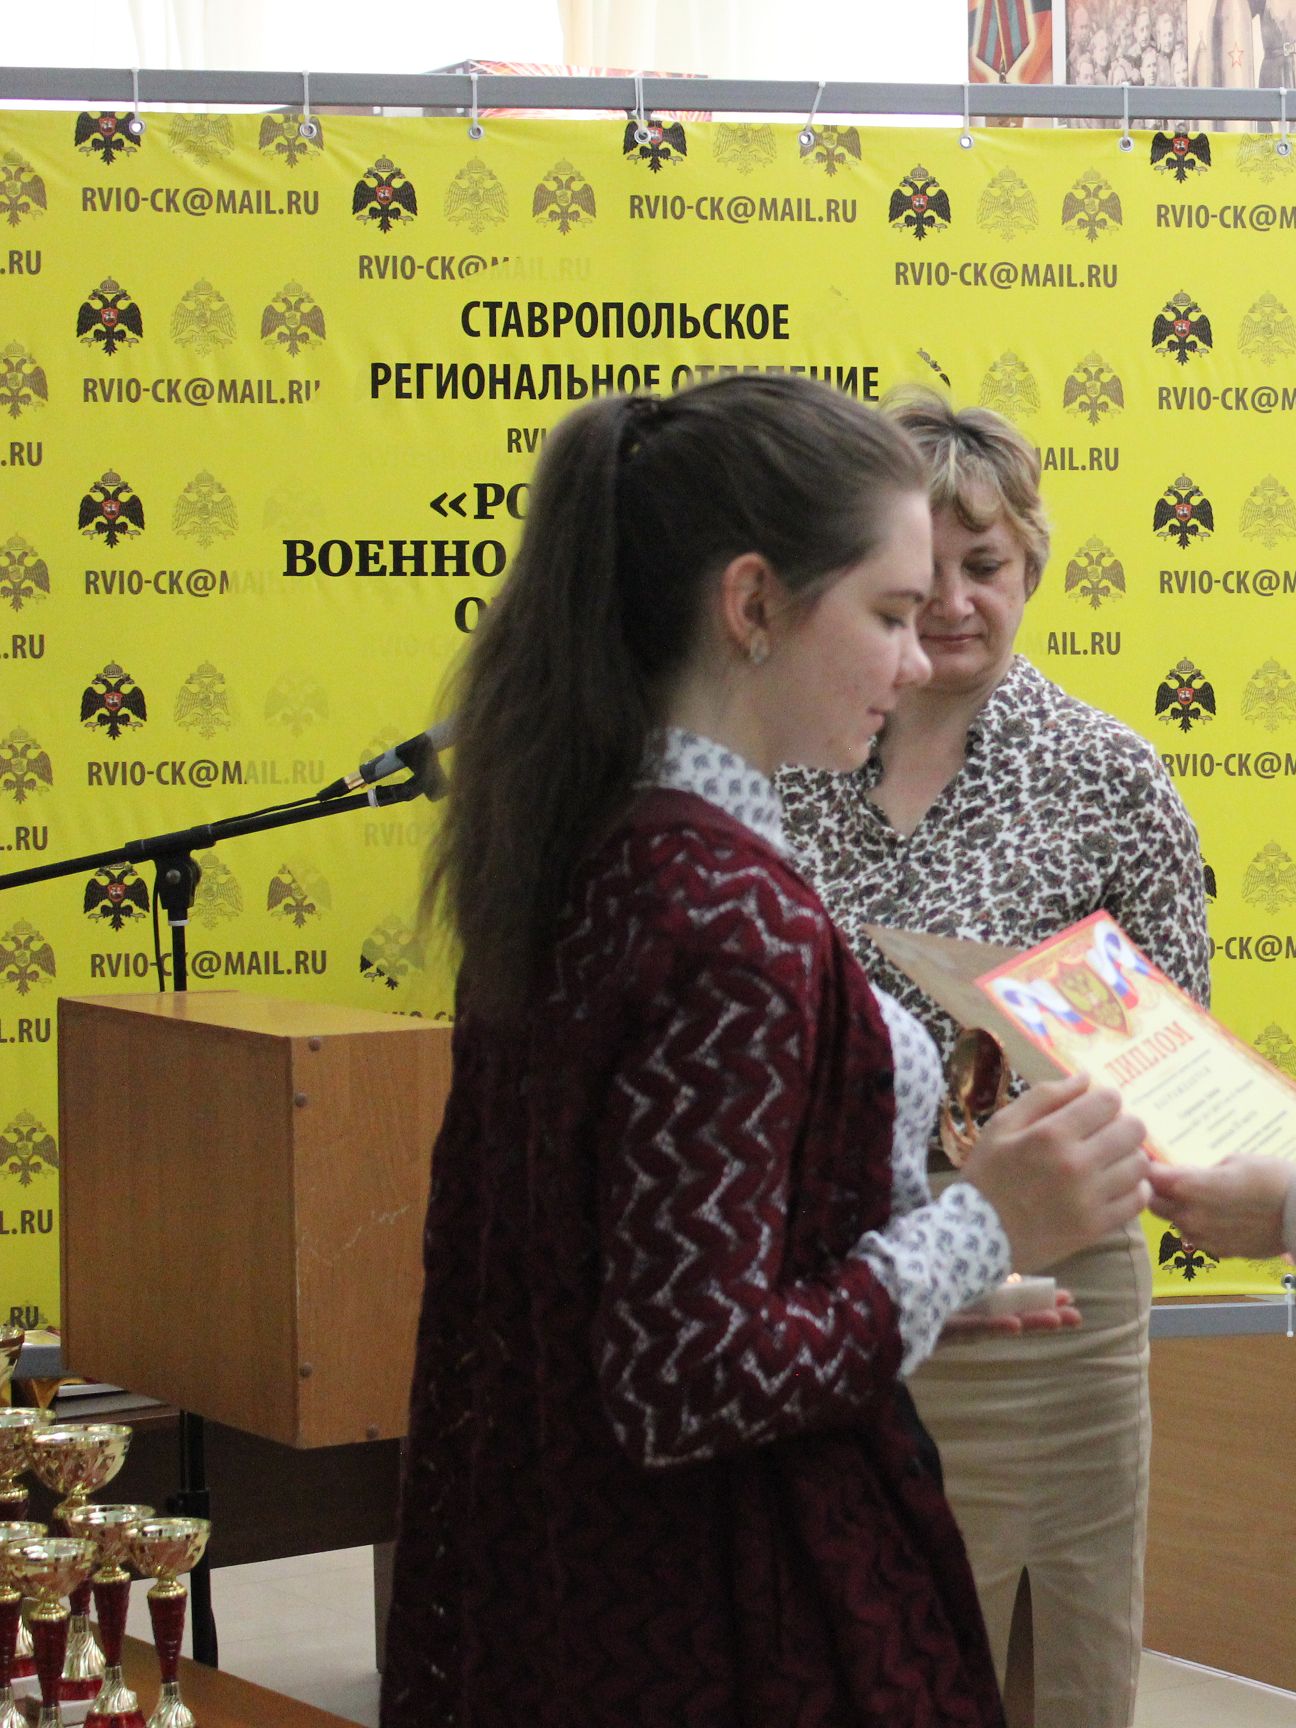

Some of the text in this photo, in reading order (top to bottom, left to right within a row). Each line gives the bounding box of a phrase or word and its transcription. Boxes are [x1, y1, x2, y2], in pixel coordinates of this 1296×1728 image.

[81, 186, 320, 217] RVIO-CK@MAIL.RU
[629, 194, 857, 224] RVIO-CK@MAIL.RU
[895, 261, 1118, 290] RVIO-CK@MAIL.RU
[461, 300, 790, 341] СТАВРОПОЛЬСКОЕ
[370, 362, 660, 400] РЕГИОНАЛЬНОЕ
[0, 633, 46, 660] .RU
[90, 950, 327, 979] RVIO-C@MAIL.RU
[1103, 1020, 1196, 1089] ДИПЛОМ
